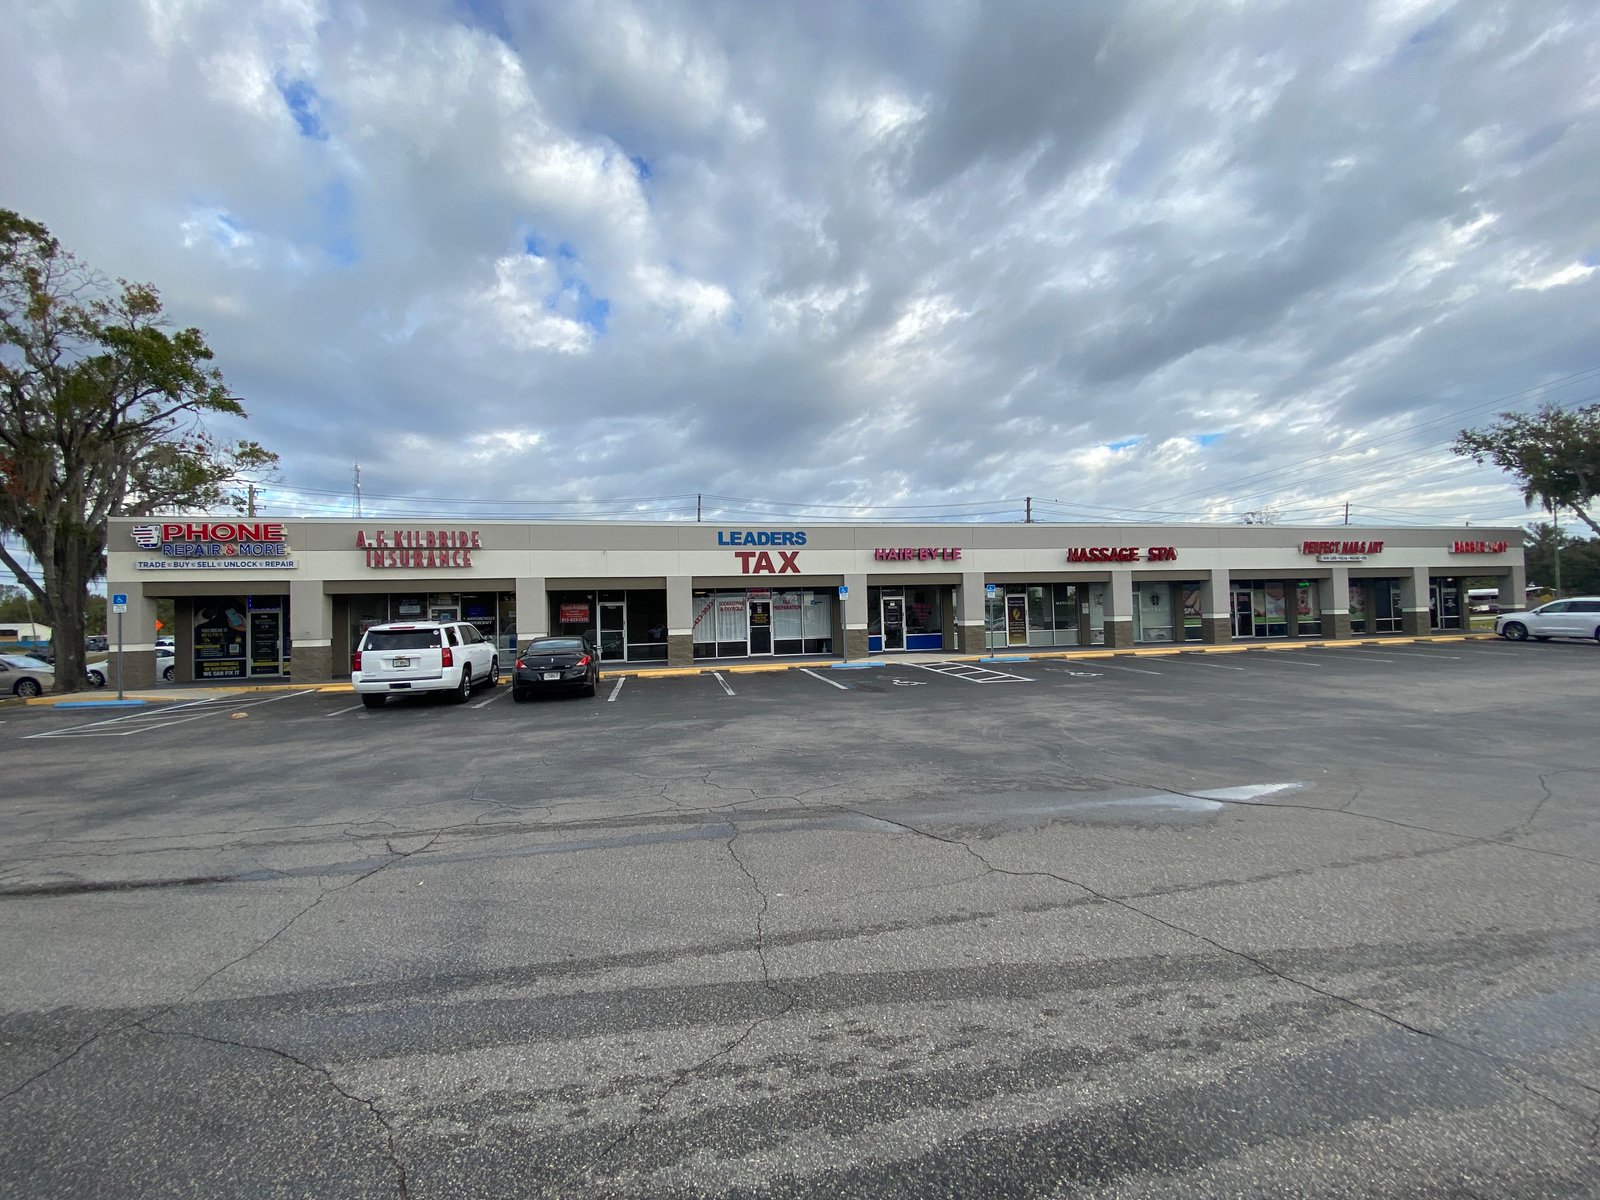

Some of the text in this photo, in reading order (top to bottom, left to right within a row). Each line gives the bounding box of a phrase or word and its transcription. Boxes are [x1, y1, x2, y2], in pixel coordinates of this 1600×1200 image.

[162, 523, 285, 542] PHONE
[394, 530, 481, 548] KILBRIDE
[717, 531, 807, 546] LEADERS
[162, 543, 286, 557] REPAIR & MORE
[875, 548, 962, 561] HAIR BY LE
[1067, 547, 1177, 562] MASSAGE SPA
[1303, 541, 1384, 554] PERFECT NAILS ART
[366, 549, 473, 568] INSURANCE
[734, 551, 801, 574] TAX
